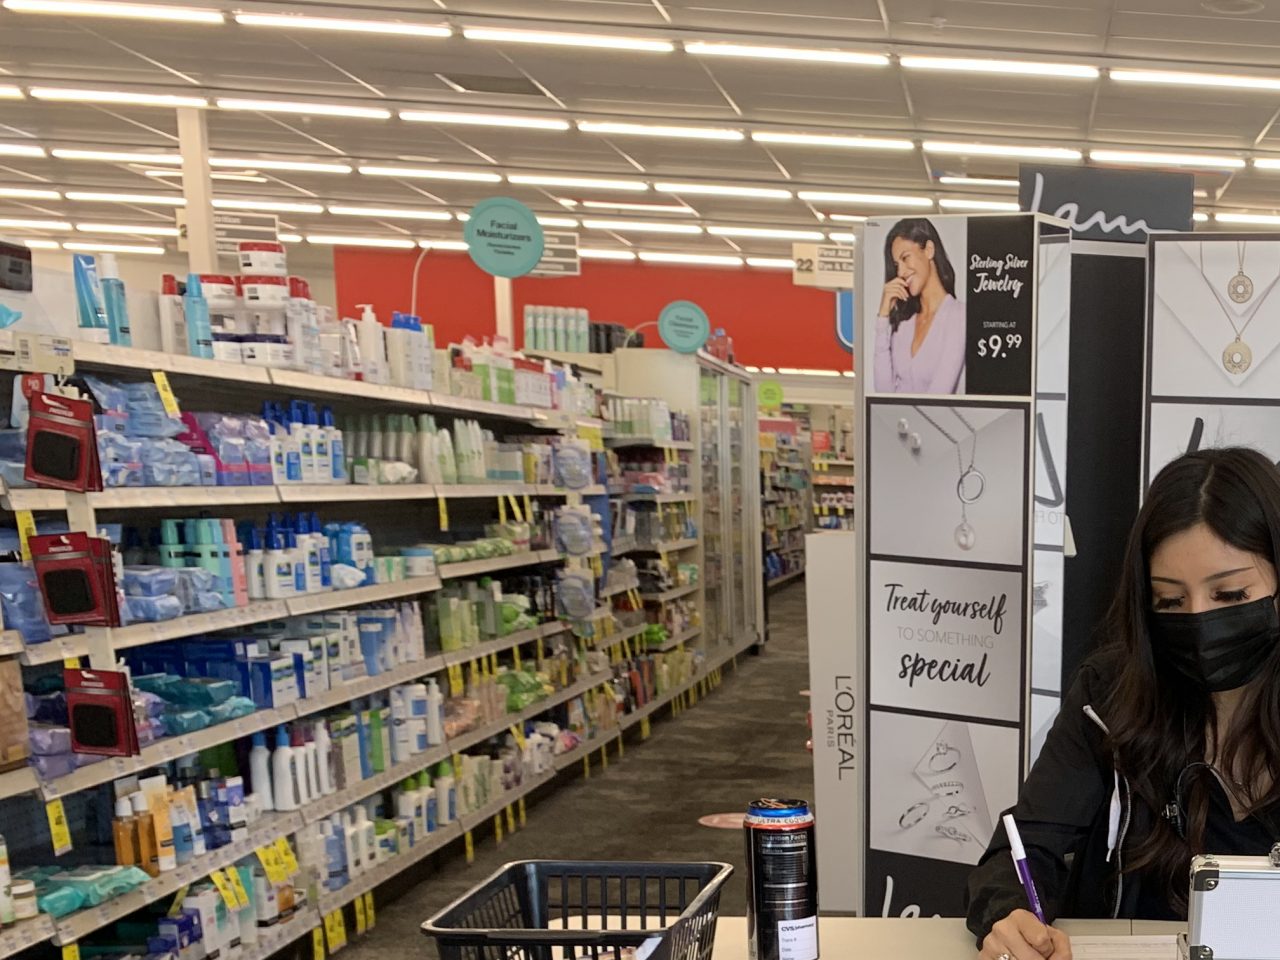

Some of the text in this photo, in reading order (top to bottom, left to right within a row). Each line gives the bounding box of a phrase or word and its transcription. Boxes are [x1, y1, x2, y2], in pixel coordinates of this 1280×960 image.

[476, 229, 532, 242] Moisturizers
[490, 220, 517, 230] Facial
[796, 258, 813, 272] 22
[969, 253, 1028, 276] Sterling Silver
[973, 272, 1024, 298] Jewelry
[884, 583, 1007, 635] Treat yourself
[897, 626, 995, 649] TO SOMETHING
[899, 653, 991, 688] special
[827, 710, 835, 748] PARIS
[835, 675, 855, 780] L'ORÉAL
